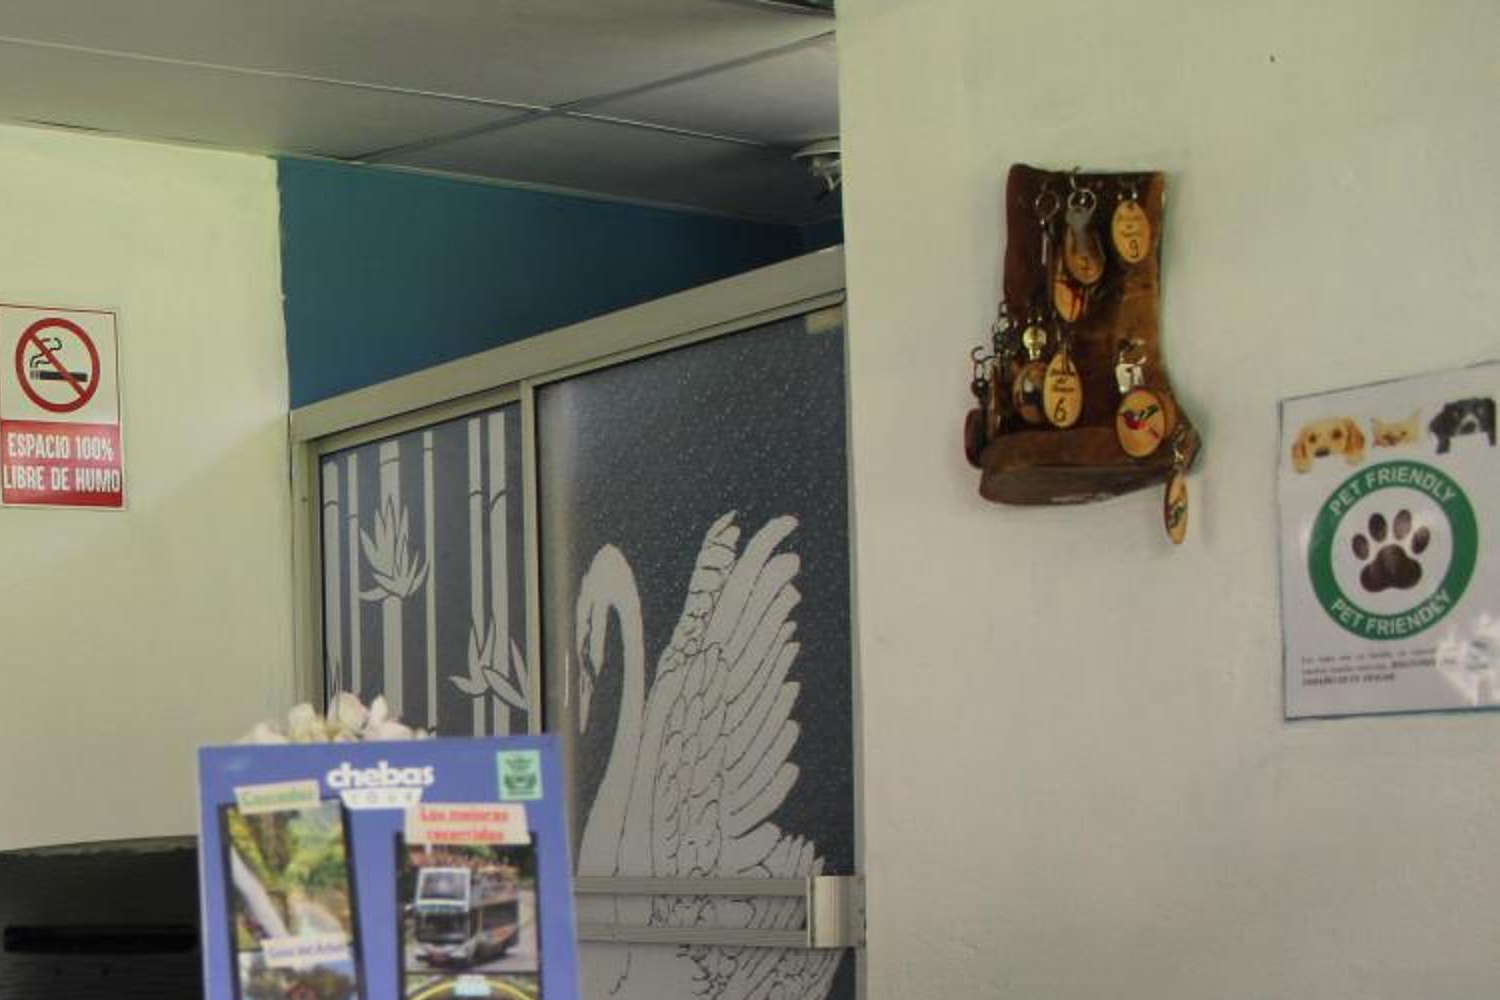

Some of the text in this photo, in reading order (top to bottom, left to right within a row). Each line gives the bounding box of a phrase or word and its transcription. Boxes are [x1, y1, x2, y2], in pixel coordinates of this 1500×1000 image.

[7, 432, 115, 461] ESPACIO 100%
[3, 464, 121, 492] LIBRE DE HUMO
[1329, 466, 1456, 516] PET FRIENDLY
[1331, 589, 1451, 636] PET FRIENDLY
[326, 760, 435, 789] chebas
